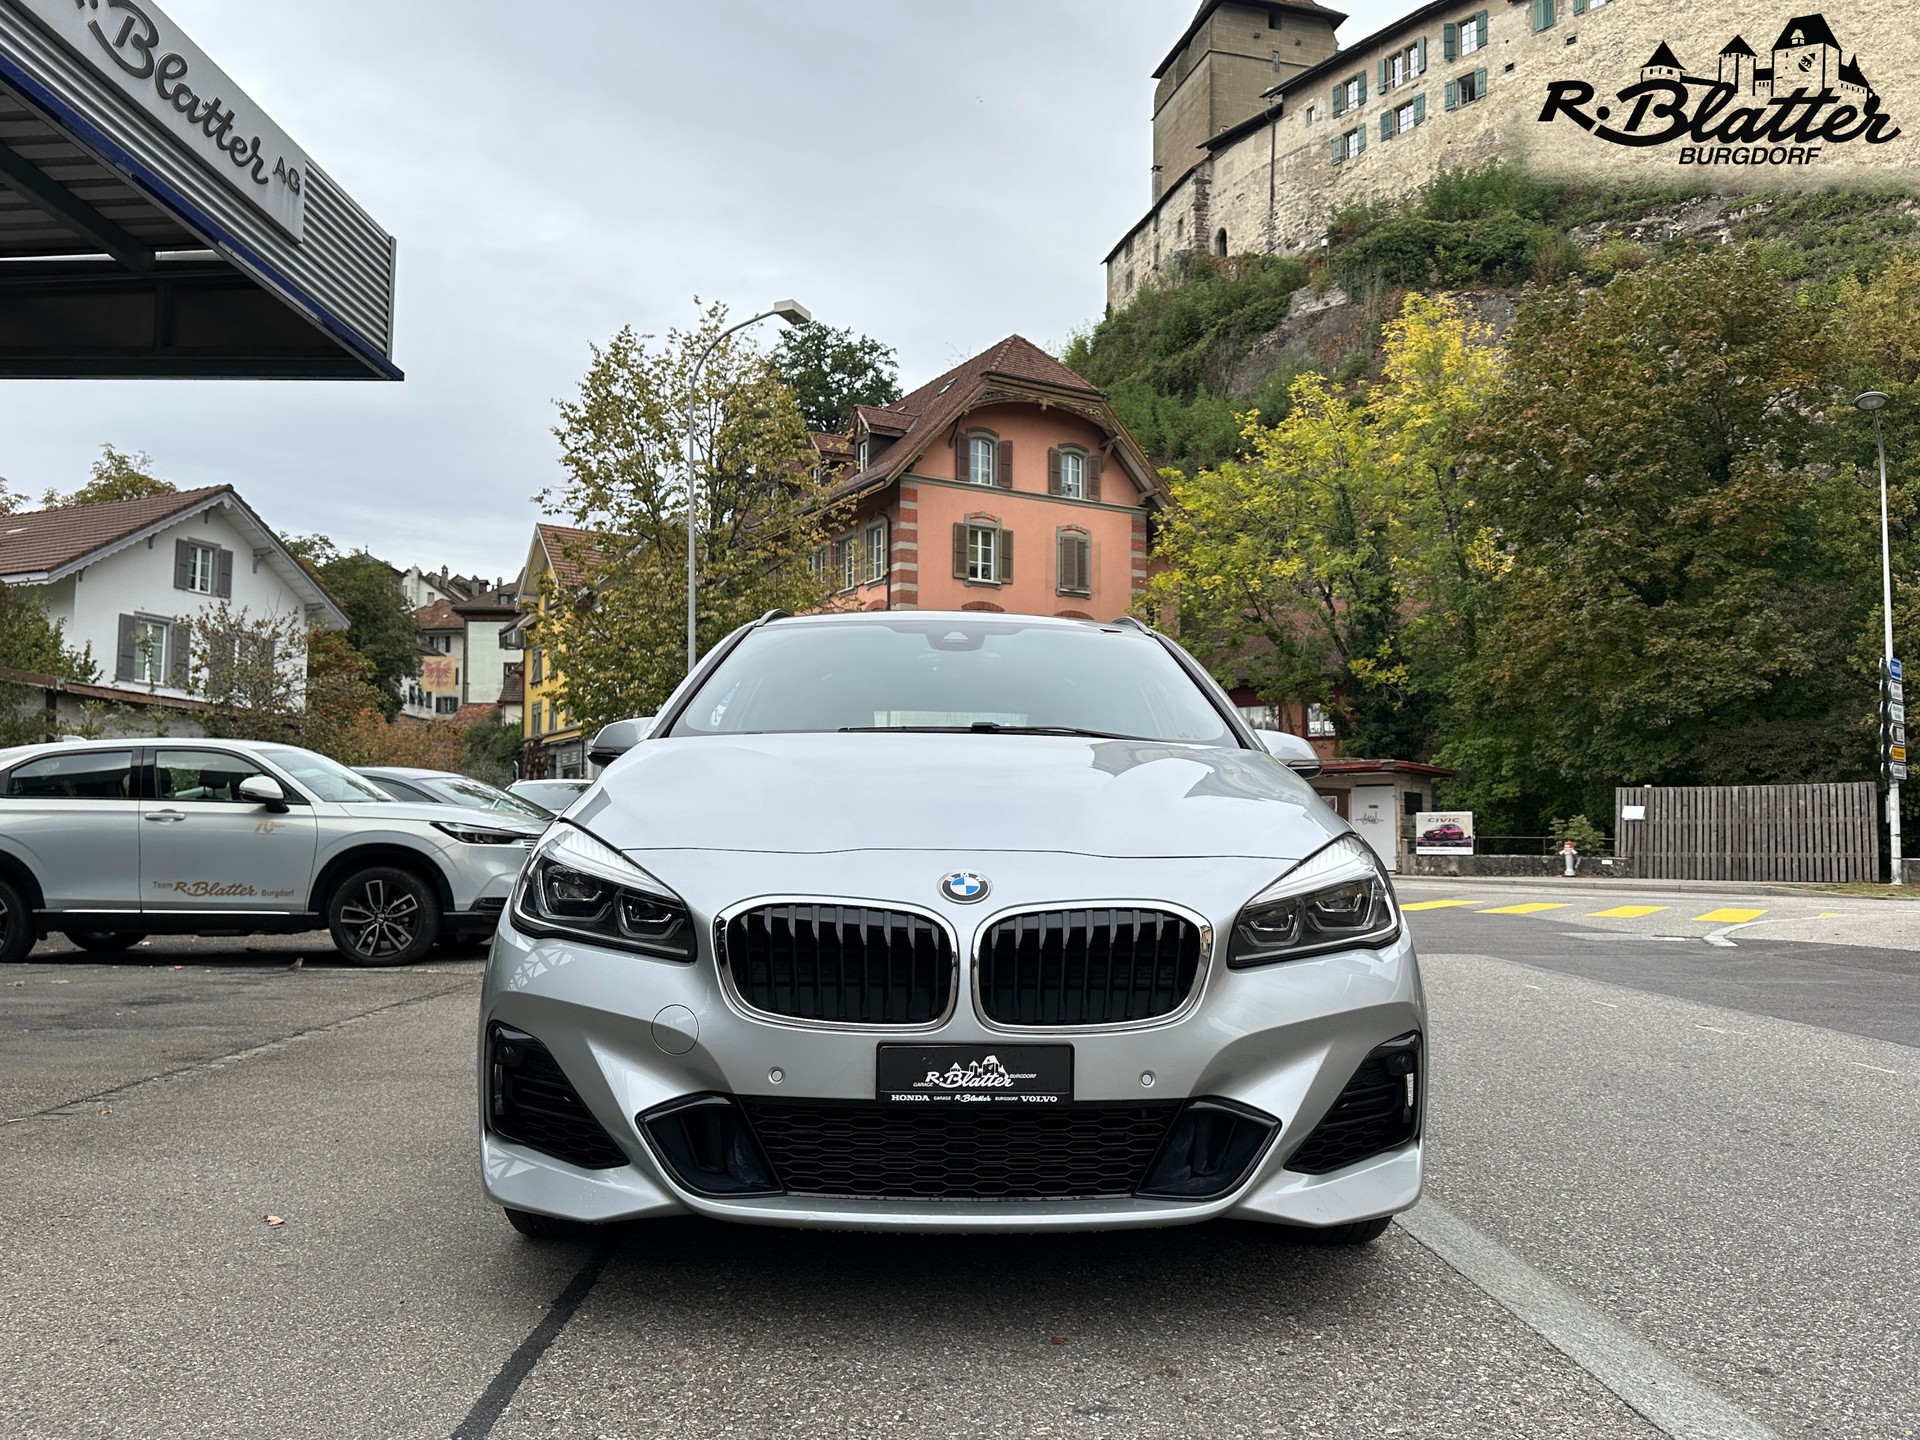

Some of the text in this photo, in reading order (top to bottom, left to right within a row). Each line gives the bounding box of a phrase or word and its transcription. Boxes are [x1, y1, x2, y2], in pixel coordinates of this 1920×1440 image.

[273, 156, 301, 195] AG
[153, 881, 173, 889] Team
[261, 889, 295, 898] Burgdorf
[891, 1094, 931, 1102] HONDA
[1020, 1095, 1058, 1103] VOLVO
